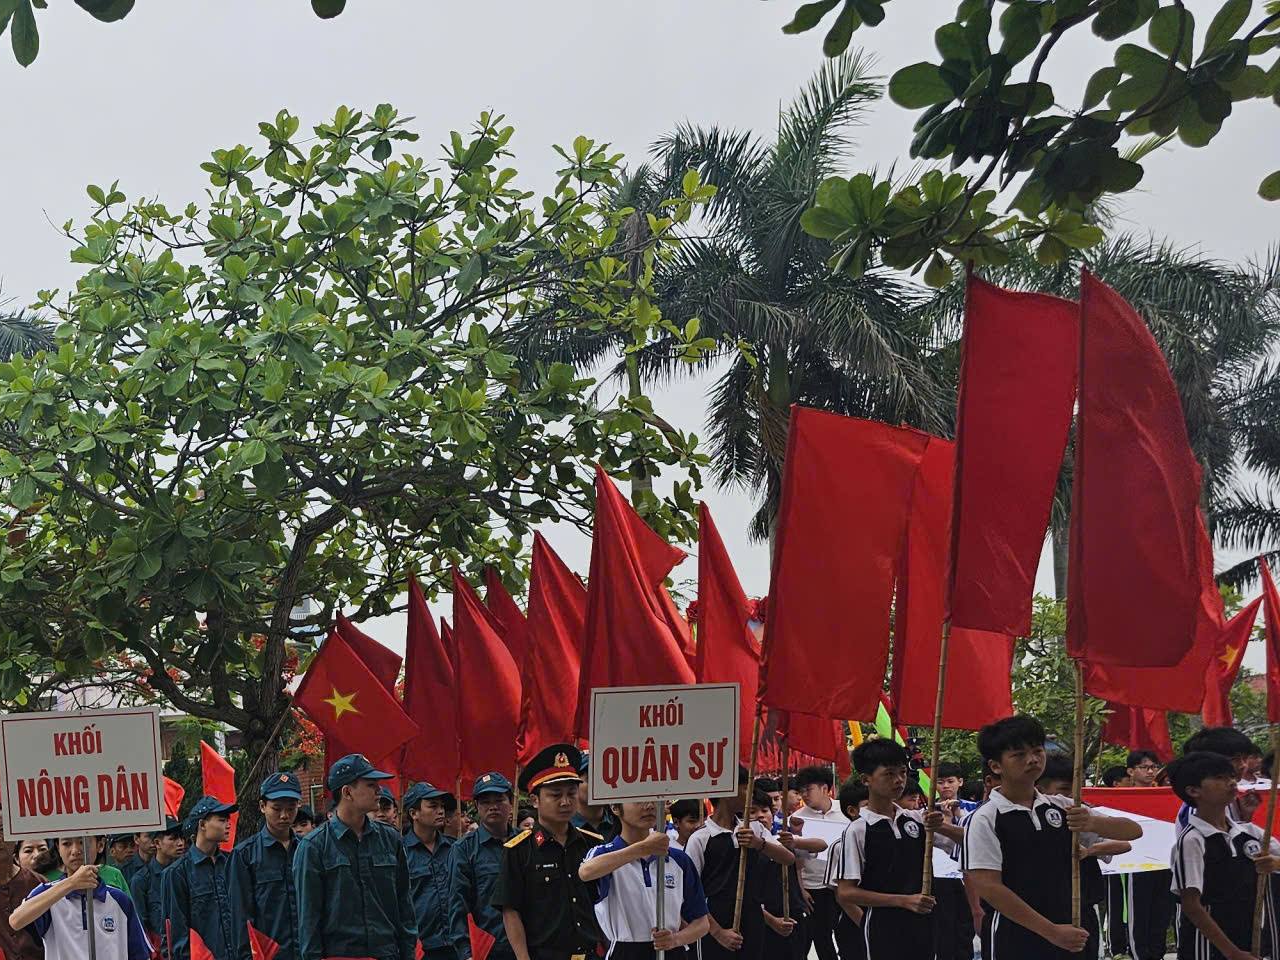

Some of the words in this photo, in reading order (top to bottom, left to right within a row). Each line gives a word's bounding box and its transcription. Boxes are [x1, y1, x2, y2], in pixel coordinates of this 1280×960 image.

[639, 696, 684, 728] KHỐI
[53, 723, 103, 757] KHỐI
[602, 737, 679, 789] QUÂN
[688, 737, 729, 786] SỰ
[16, 768, 91, 818] NÔNG
[97, 765, 150, 813] DÂN
